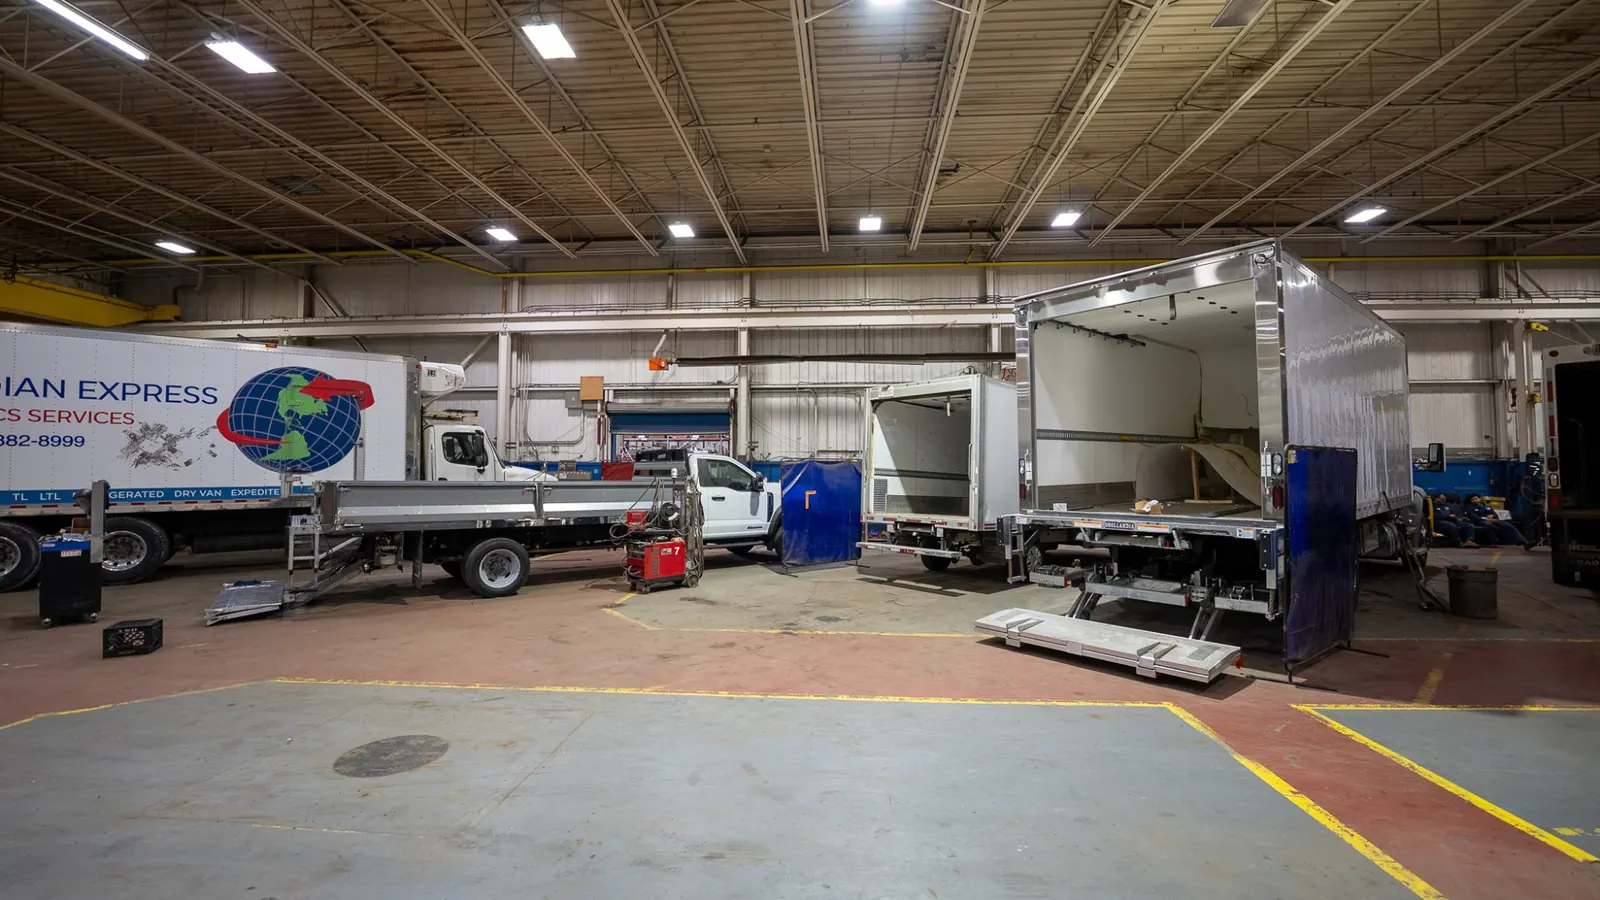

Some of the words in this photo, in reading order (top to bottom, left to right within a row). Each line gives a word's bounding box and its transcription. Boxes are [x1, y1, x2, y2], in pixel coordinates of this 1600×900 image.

[0, 377, 65, 399] IAN
[79, 381, 218, 405] EXPRESS
[28, 409, 135, 425] SERVICES
[12, 493, 29, 501] TL
[40, 492, 61, 501] LTL
[174, 489, 196, 498] DRY
[199, 489, 222, 497] VAN
[674, 546, 680, 555] 7
